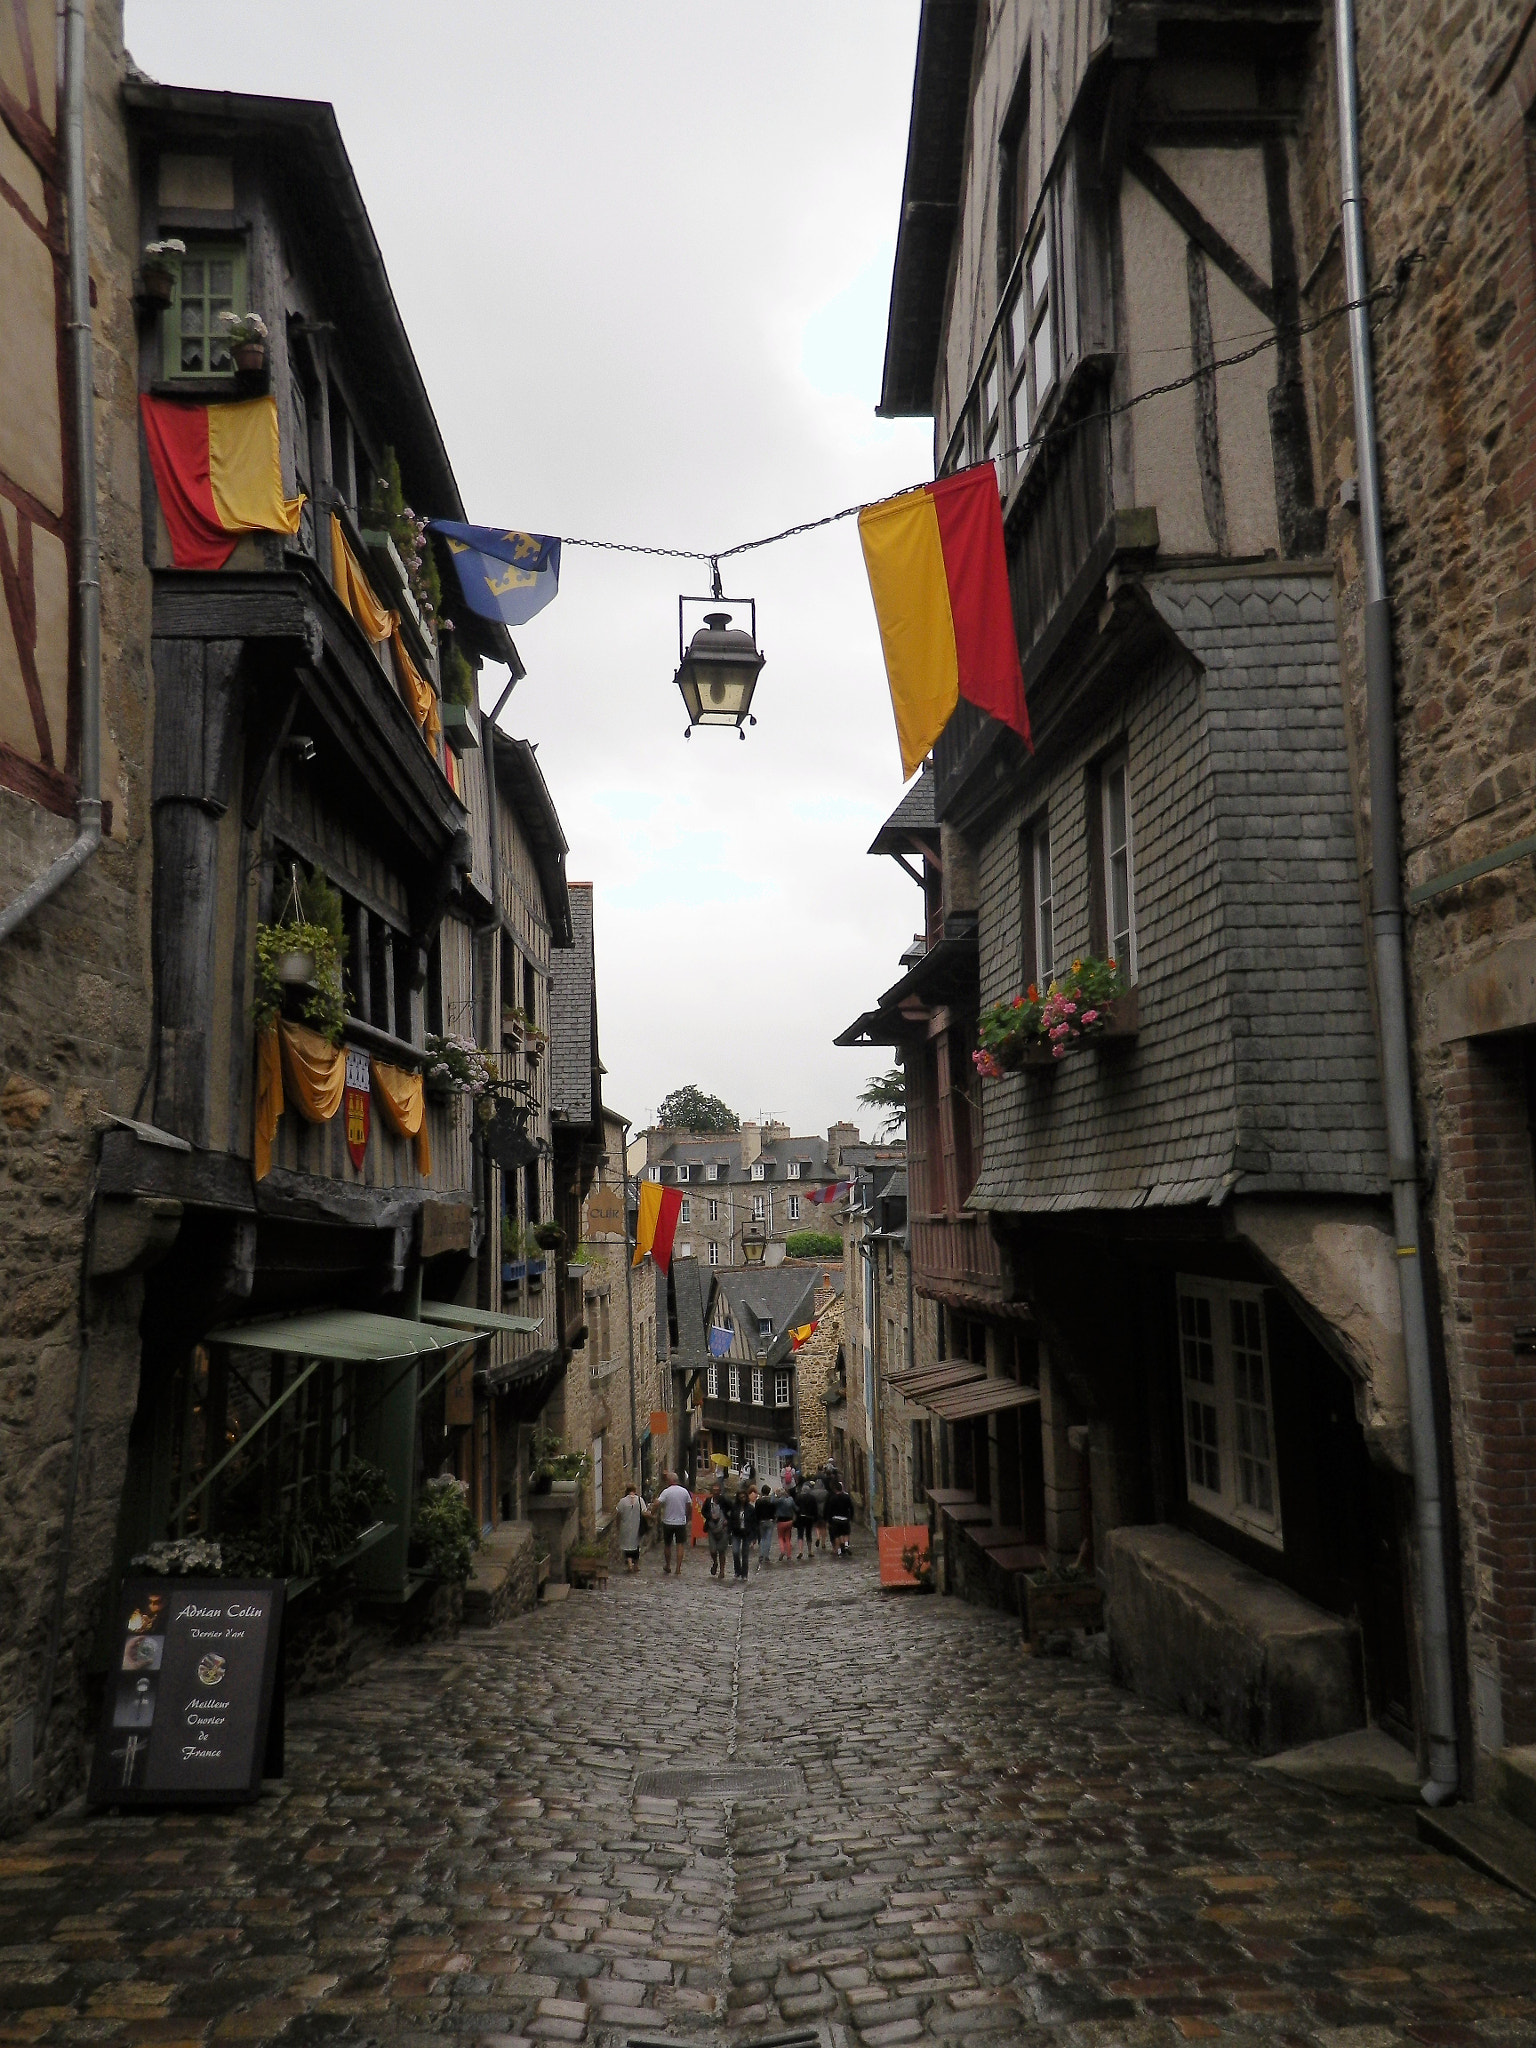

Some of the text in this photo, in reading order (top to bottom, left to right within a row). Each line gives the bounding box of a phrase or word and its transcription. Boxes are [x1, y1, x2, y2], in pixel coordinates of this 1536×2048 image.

[175, 1604, 262, 1620] Adrian Colin
[190, 1628, 246, 1638] Verrier d'art
[184, 1698, 230, 1711] Meilleur
[187, 1714, 225, 1725] Ouvrier
[198, 1730, 209, 1741] de
[181, 1746, 222, 1760] France
